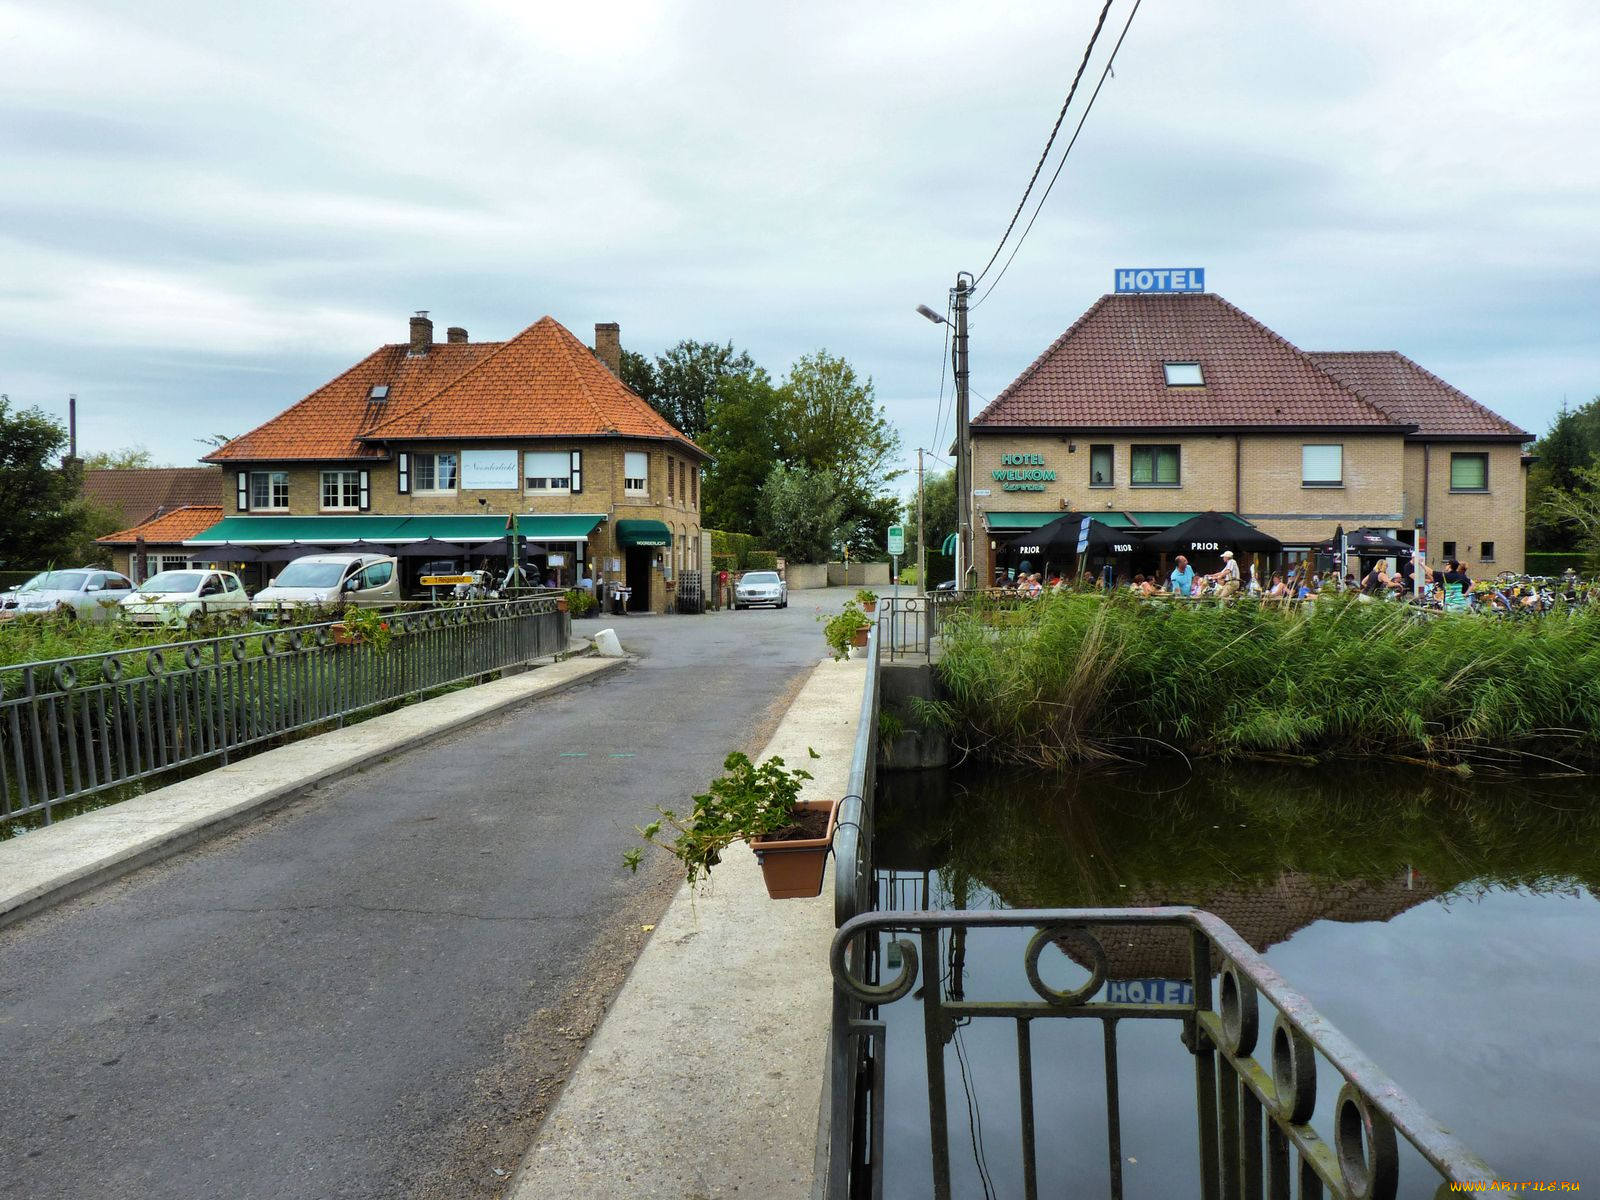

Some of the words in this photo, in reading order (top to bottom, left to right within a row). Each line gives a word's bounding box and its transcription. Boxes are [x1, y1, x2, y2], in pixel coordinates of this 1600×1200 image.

[1119, 270, 1202, 290] HOTEL
[1001, 453, 1045, 465] HOTEL
[992, 469, 1057, 481] WELKOM
[1019, 545, 1040, 554] PRIOR
[1113, 544, 1133, 552] PRIOR
[1191, 542, 1219, 550] PRIOR
